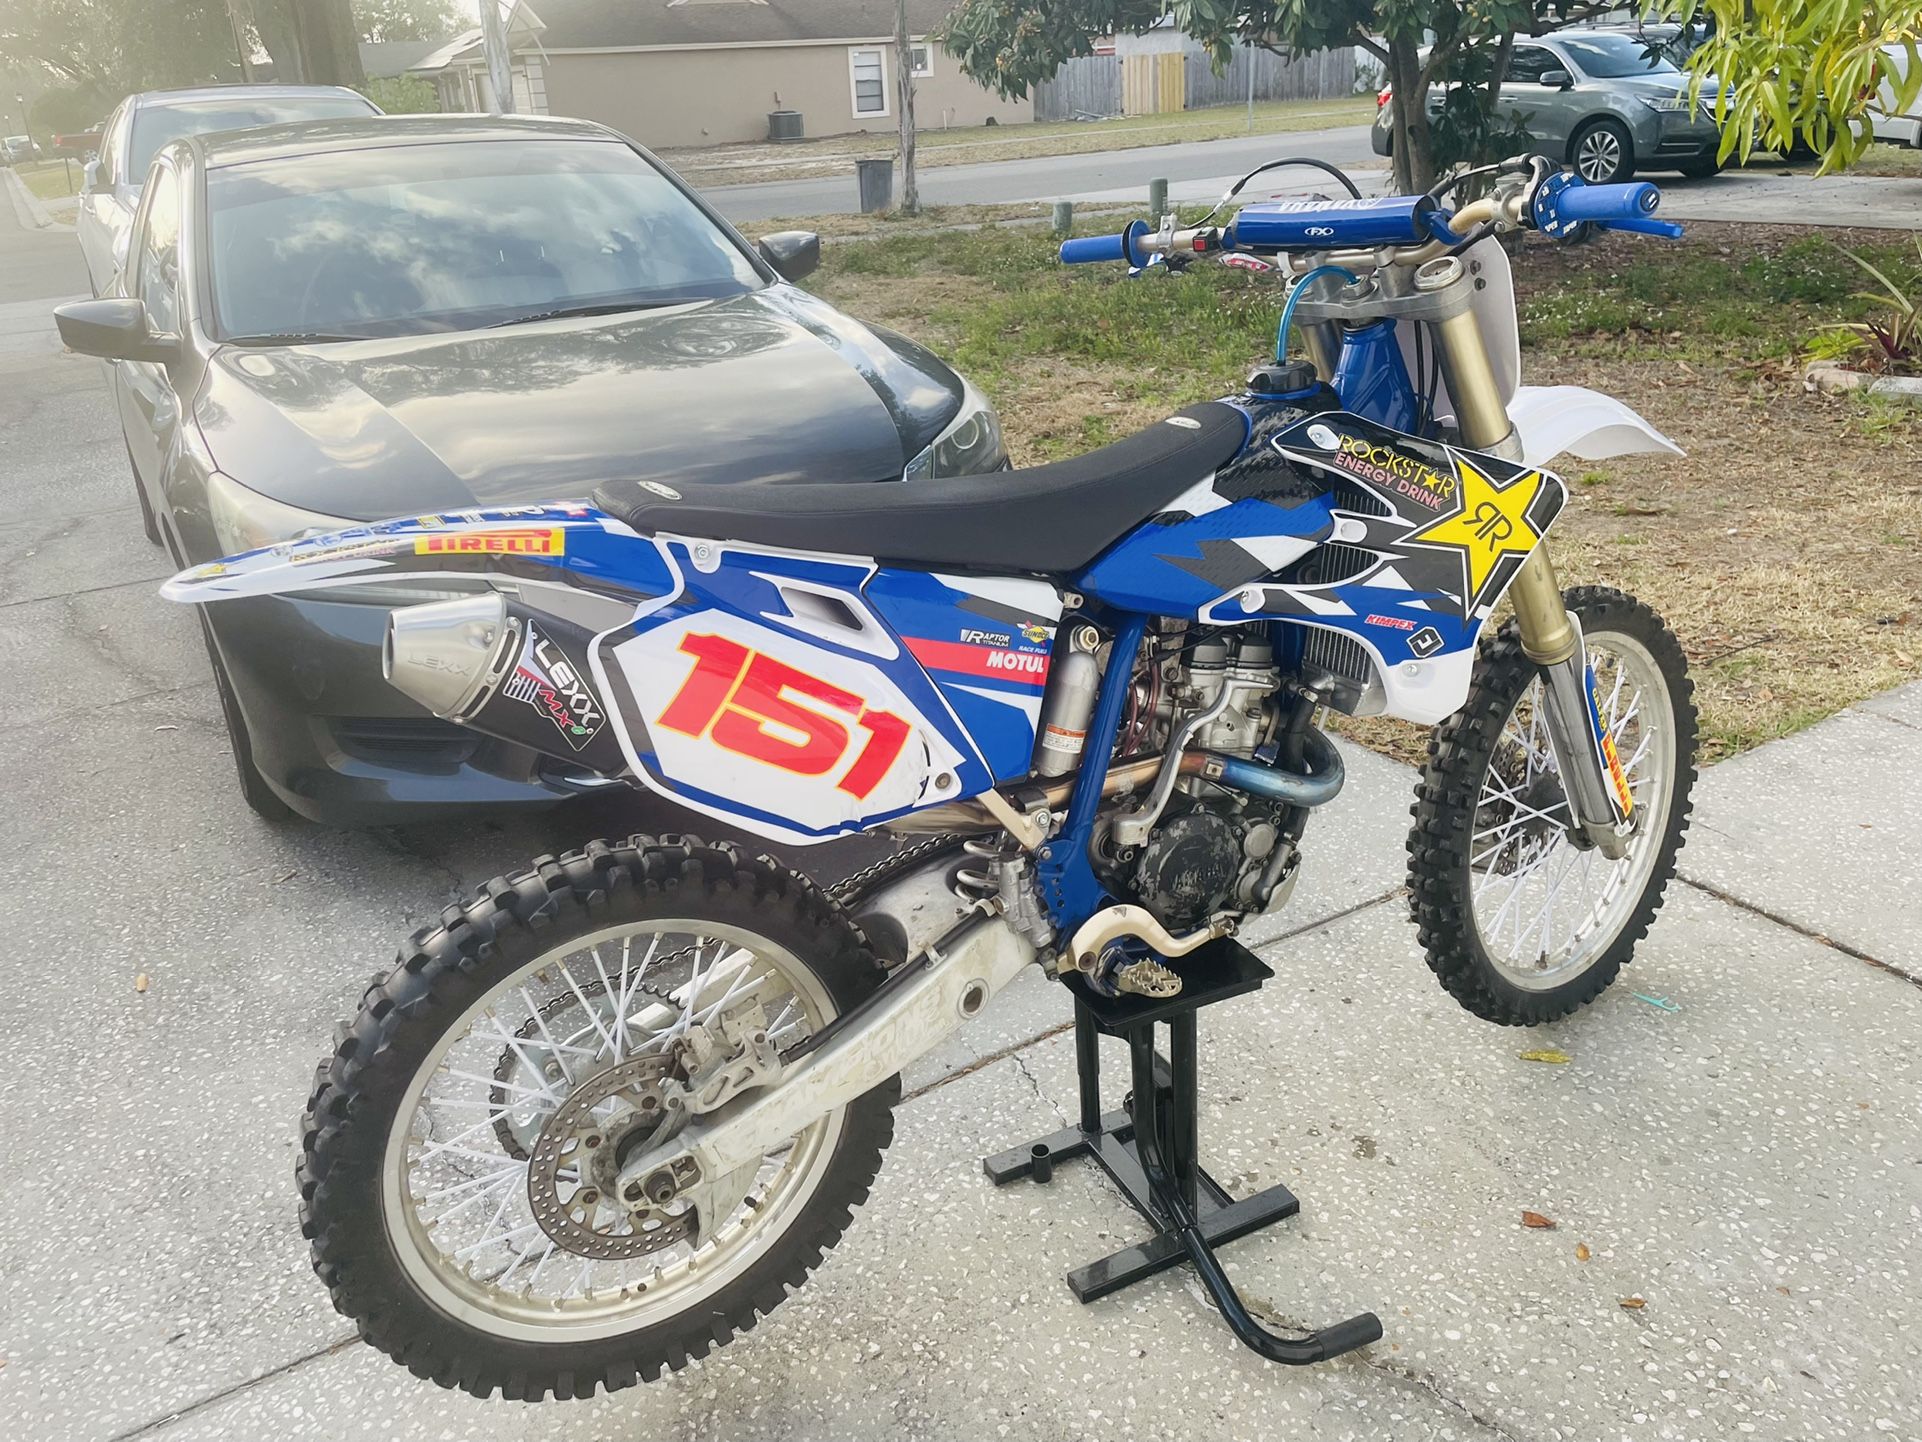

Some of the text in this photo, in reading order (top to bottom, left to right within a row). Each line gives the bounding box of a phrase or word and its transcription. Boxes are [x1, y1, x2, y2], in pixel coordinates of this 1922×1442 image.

[1334, 452, 1444, 511] ENERGY DRINK
[428, 529, 551, 553] PIRELLI
[1364, 614, 1417, 631] KIMPEX
[408, 654, 469, 677] LEXX
[986, 651, 1044, 673] MOTUL
[535, 639, 600, 727] LEXX
[655, 631, 912, 802] 151
